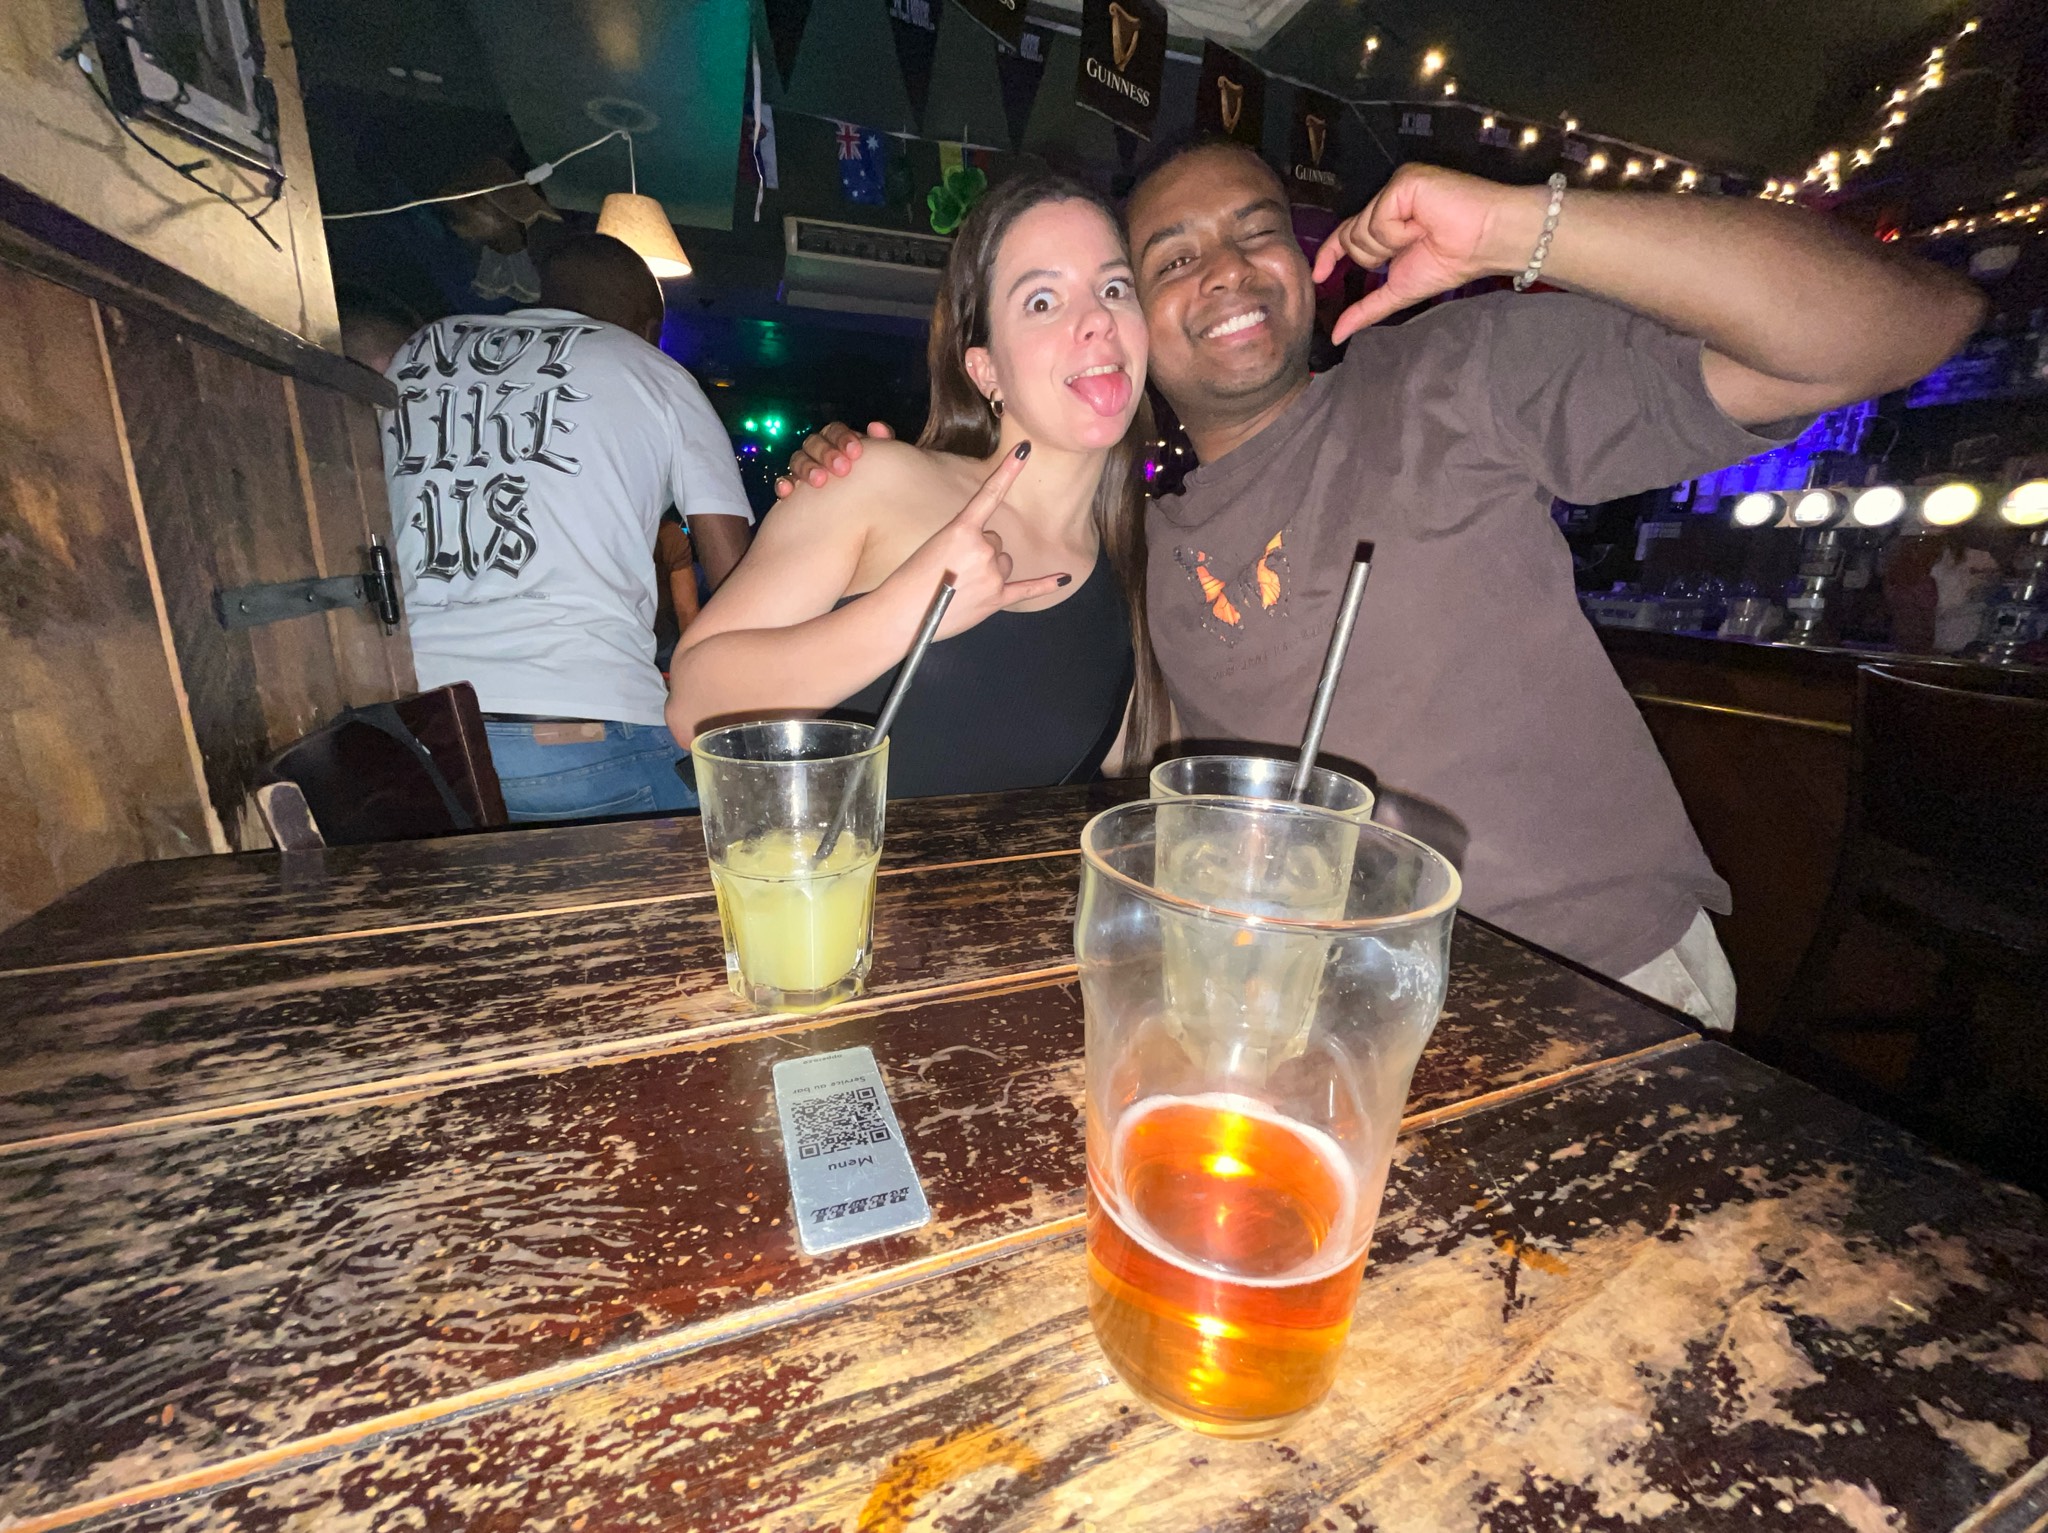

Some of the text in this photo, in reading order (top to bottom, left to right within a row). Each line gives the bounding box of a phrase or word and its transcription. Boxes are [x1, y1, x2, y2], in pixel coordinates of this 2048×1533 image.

[1086, 57, 1151, 107] GUINNESS
[397, 322, 604, 380] NOT
[388, 381, 593, 478] LIKE
[411, 472, 539, 583] US
[793, 1086, 811, 1095] bar
[830, 1075, 866, 1087] Service
[828, 1155, 874, 1171] Menu
[810, 1187, 910, 1224] REBEL
